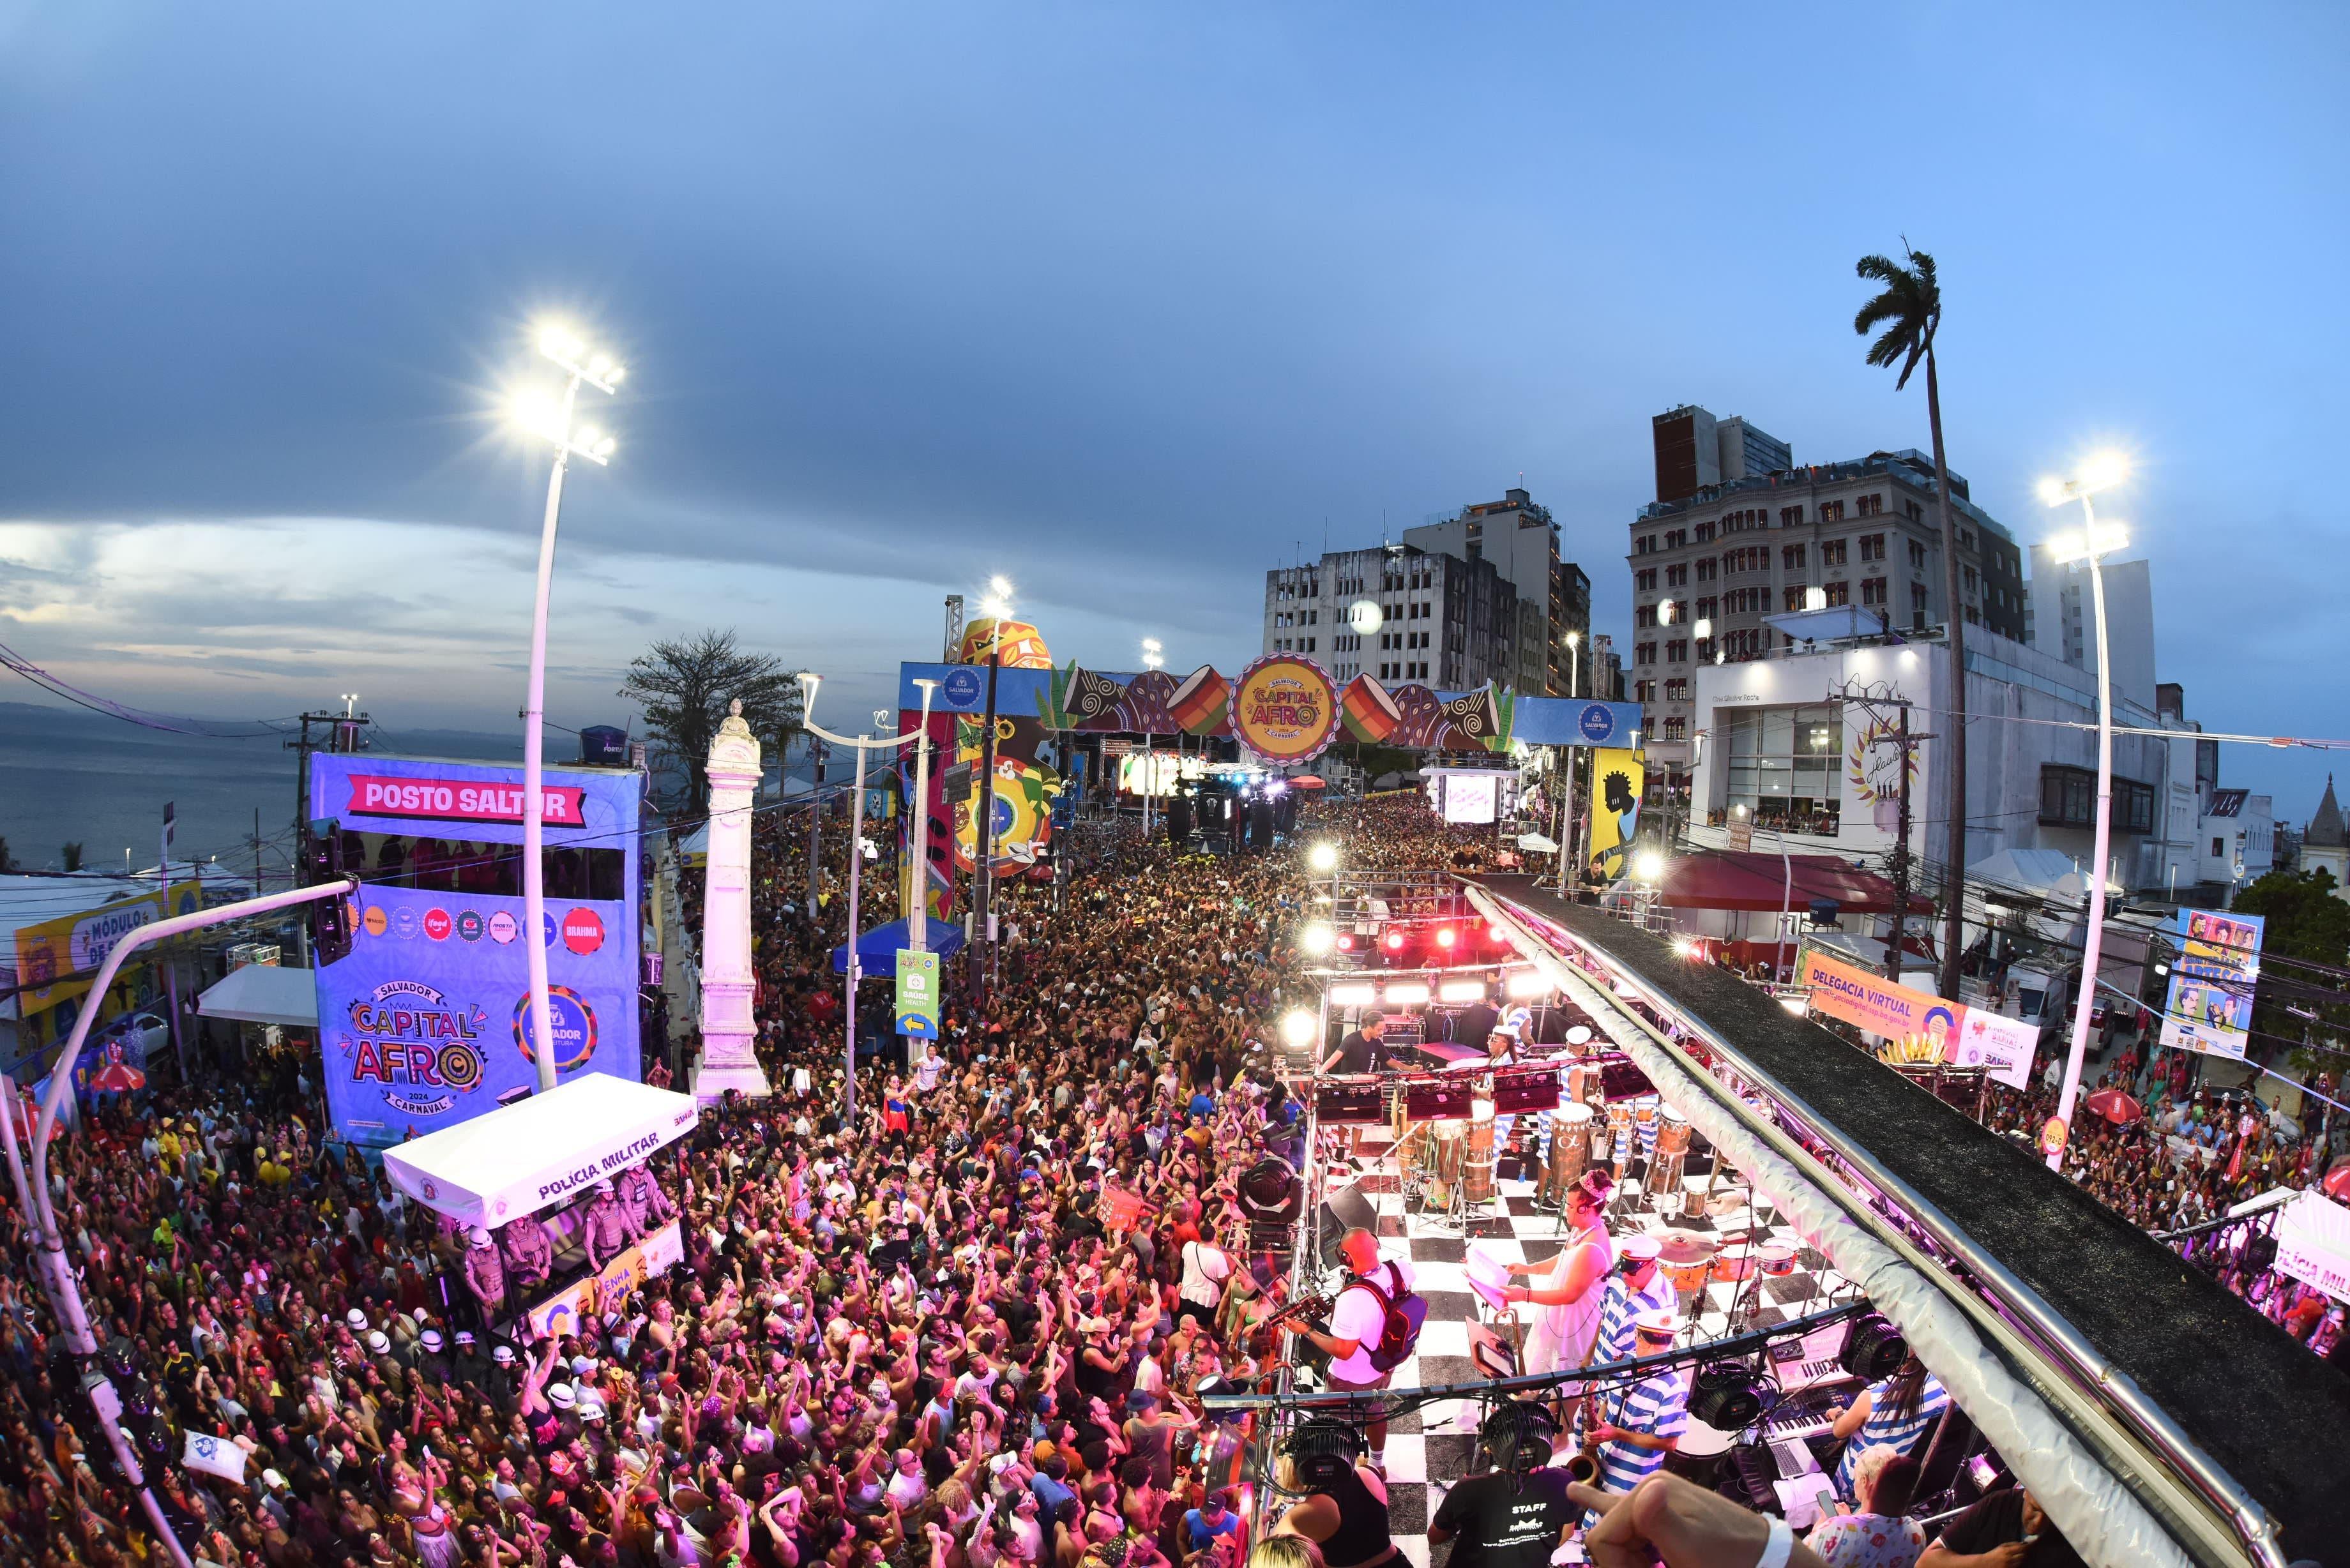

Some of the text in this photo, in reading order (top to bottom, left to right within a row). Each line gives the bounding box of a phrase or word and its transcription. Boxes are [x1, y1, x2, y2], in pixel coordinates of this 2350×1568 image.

[1254, 688, 1318, 704] CAPITAL
[1250, 704, 1319, 727] AFRO
[366, 783, 453, 811] POSTO
[92, 910, 140, 941] MÓDULO
[566, 926, 598, 937] BRAHMA
[380, 983, 432, 998] SALVADOR
[903, 990, 929, 1000] SAÚDE
[1813, 969, 1911, 1018] DELEGACIA VIRTUAL
[906, 999, 927, 1007] HEALTH
[354, 1004, 478, 1039] CAPITAL
[352, 1041, 478, 1086] AFRO
[395, 1098, 447, 1114] CARNAVAL
[674, 1109, 694, 1126] BAHIA
[538, 1132, 659, 1200] POLÍCIA MILITAR
[1512, 1503, 1547, 1514] STAFF
